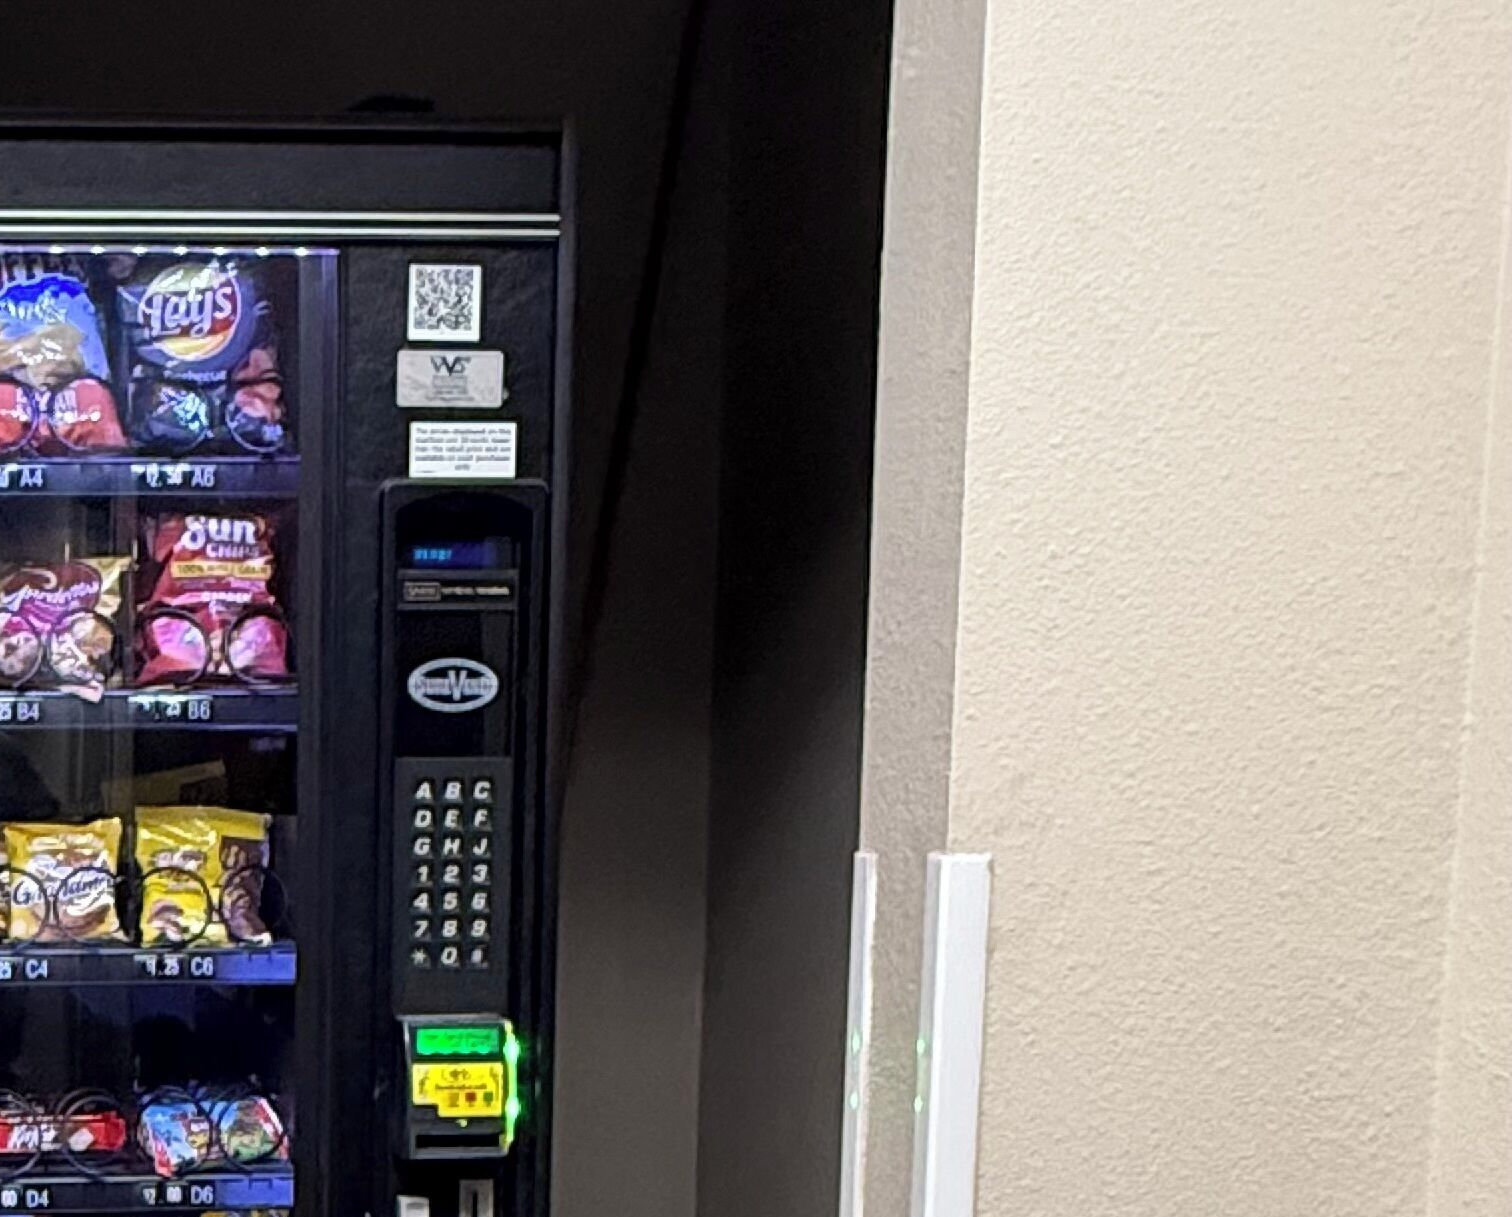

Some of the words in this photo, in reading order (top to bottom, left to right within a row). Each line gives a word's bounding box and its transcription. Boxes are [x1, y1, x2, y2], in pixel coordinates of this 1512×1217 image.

[19, 466, 44, 487] A4
[191, 466, 215, 487] A6
[16, 702, 40, 721] B4
[415, 781, 432, 800] A
[444, 781, 462, 800] B
[473, 781, 492, 800] C
[414, 809, 432, 828] D
[444, 808, 460, 828] E
[474, 808, 489, 828] F
[414, 837, 431, 856] G
[443, 838, 461, 856] H
[472, 838, 488, 856] J
[417, 865, 429, 883] 1
[443, 864, 460, 883] 2
[472, 864, 488, 883] 3
[413, 892, 429, 911] 4
[443, 892, 458, 910] 5
[471, 892, 488, 910] 6
[414, 920, 429, 938] 7
[442, 920, 458, 938] 8
[470, 919, 487, 938] 9
[441, 947, 458, 965] 0
[24, 958, 48, 979] C4
[190, 956, 214, 976] C6
[24, 1188, 50, 1208] D4
[190, 1185, 214, 1204] D6
